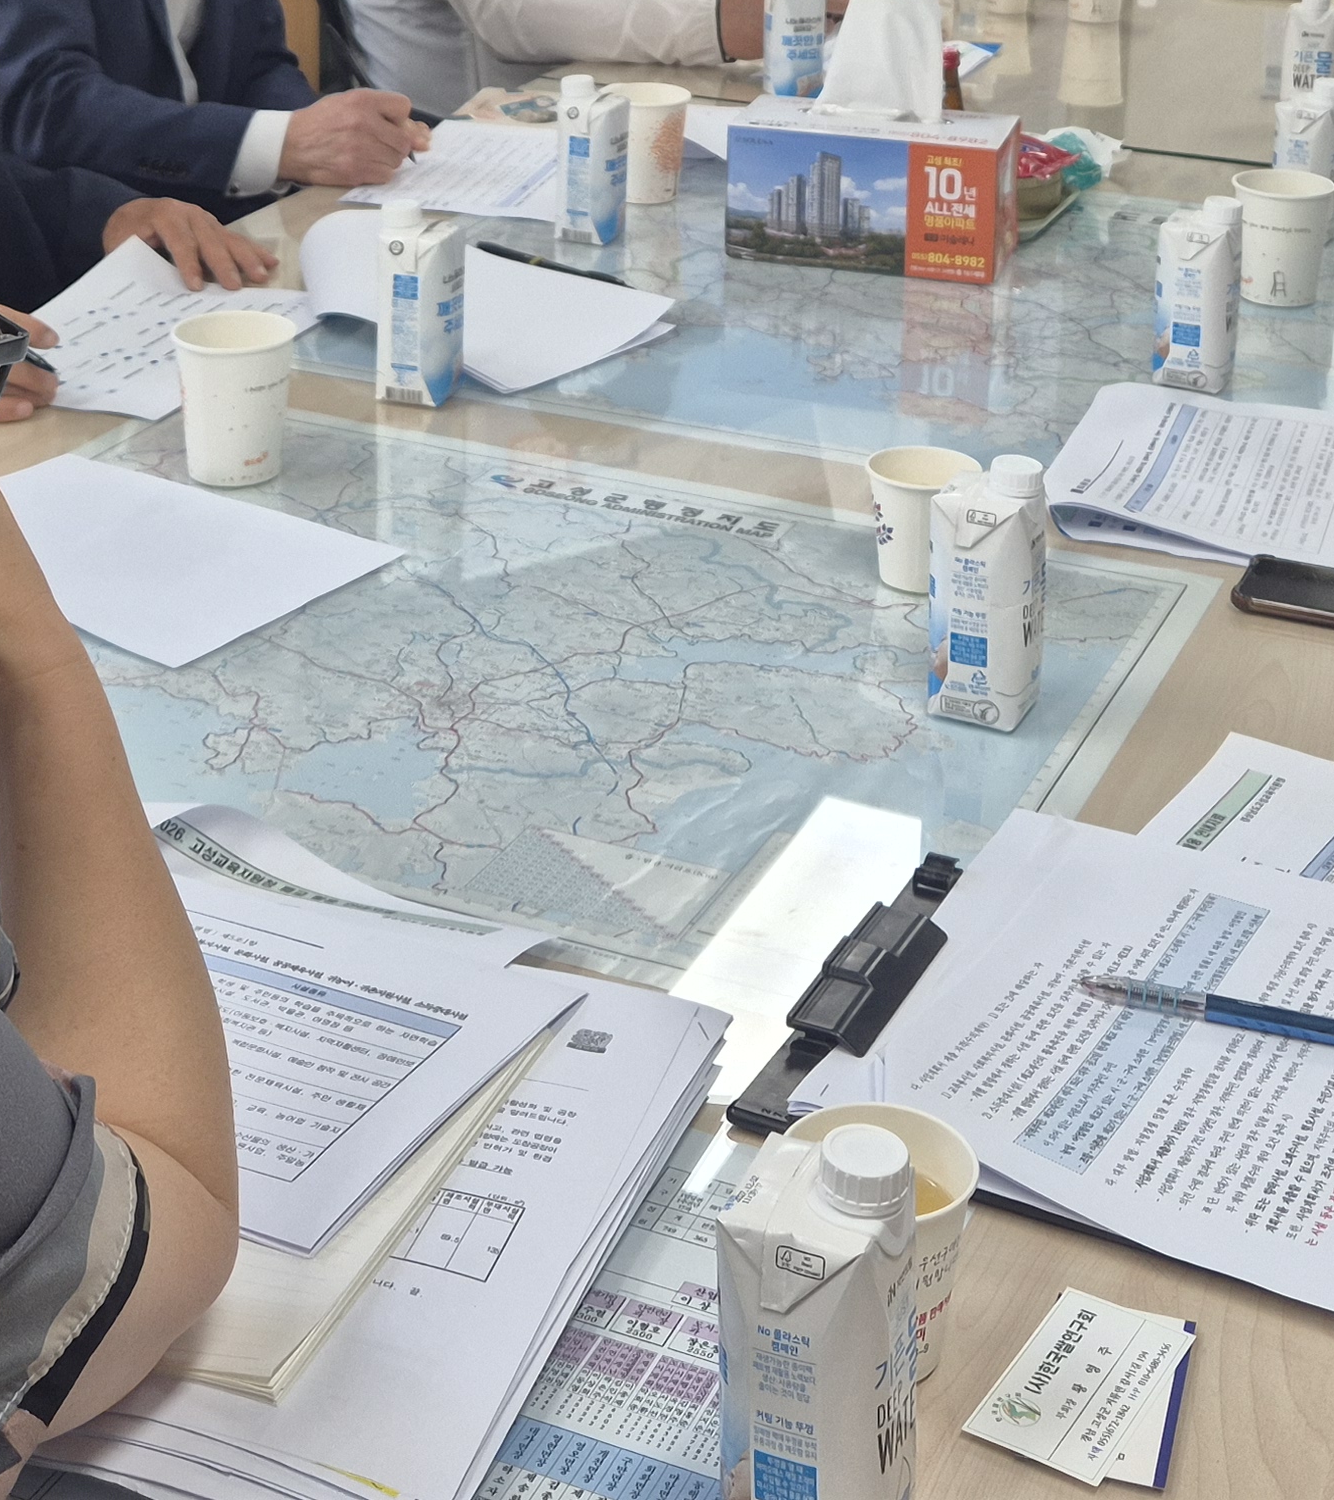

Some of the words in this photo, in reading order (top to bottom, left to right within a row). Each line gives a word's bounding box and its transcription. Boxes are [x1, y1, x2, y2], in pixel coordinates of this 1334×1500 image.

[1314, 51, 1333, 74] 물
[924, 201, 976, 218] ALL전세
[924, 216, 976, 230] 명품아파트
[522, 487, 598, 506] GOSEONG
[602, 502, 734, 532] ADMINISTRATION
[735, 527, 774, 540] MAP
[188, 836, 278, 890] 고성교육지원청
[376, 1024, 396, 1036] 하는
[371, 1079, 392, 1090] 공간
[1172, 1067, 1195, 1092] 수의계약
[557, 1109, 577, 1119] 공장
[1179, 1191, 1196, 1206] 의견
[1218, 1130, 1235, 1144] 주민
[1236, 1098, 1254, 1117] 의견이
[1234, 1142, 1253, 1161] 사업의
[1246, 1129, 1261, 1142] 경우
[1265, 1136, 1281, 1151] 요건
[492, 1165, 514, 1176] 가능
[1135, 1158, 1162, 1188] 사업계획서
[1156, 1134, 1179, 1159] 제출자가
[1158, 1167, 1183, 1196] 사업계획서
[1254, 1197, 1271, 1212] 또는
[1265, 1206, 1289, 1233] 계획서를
[1282, 1184, 1302, 1205] 제출할
[1294, 1175, 1306, 1183] 수
[1296, 1180, 1327, 1221] 사업계획서가
[1311, 1221, 1328, 1237] 시설
[1304, 1238, 1319, 1247] 는
[625, 1327, 654, 1341] 2500
[757, 1324, 771, 1337] No
[773, 1328, 811, 1349] 플라스틱
[686, 1346, 715, 1360] 2550
[771, 1340, 799, 1358] 캠페인
[1025, 1309, 1096, 1394] (사)한국쌀연구회
[877, 1380, 903, 1430] DEEP
[1055, 1398, 1077, 1419] 부회장
[1080, 1428, 1097, 1442] 경남
[1091, 1406, 1112, 1429] 고성군
[1105, 1385, 1126, 1407] 거류면
[1136, 1350, 1149, 1363] 194
[756, 1410, 774, 1425] 커팅
[775, 1414, 793, 1429] 기능
[795, 1421, 815, 1436] 뚜껑
[877, 1382, 917, 1475] WATE
[1087, 1445, 1103, 1461] 자택
[1097, 1404, 1131, 1447] 055)672-1842
